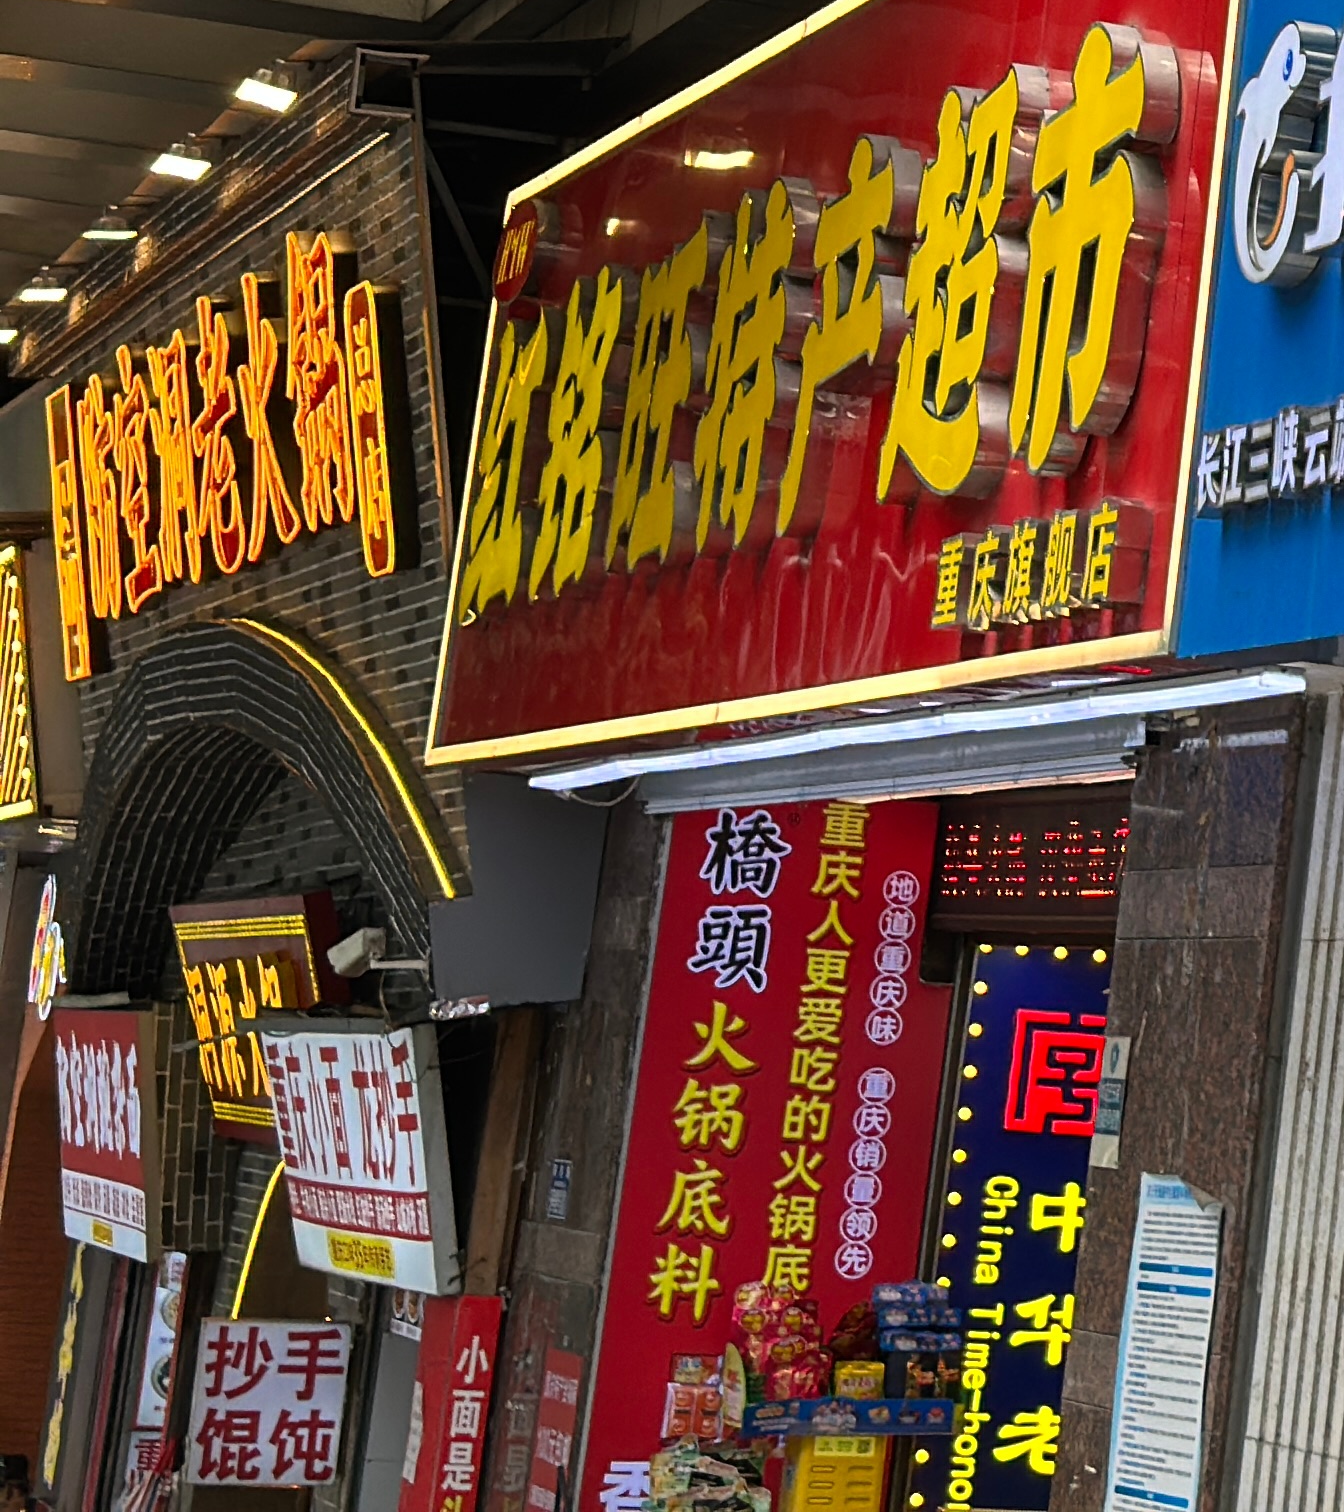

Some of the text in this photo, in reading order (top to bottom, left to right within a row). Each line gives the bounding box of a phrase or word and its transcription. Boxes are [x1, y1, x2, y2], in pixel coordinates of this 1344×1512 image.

[458, 21, 1145, 624] 红铭旺特产超市
[1197, 408, 1299, 512] 长江三峡
[931, 502, 1120, 631] 重庆旗舰店
[264, 1040, 353, 1181] 重庆小面
[647, 807, 793, 1324] 橋頭 火锅底料
[761, 800, 871, 1291] 重庆人更爱吃的火锅底
[836, 873, 917, 1277] 地道重庆味 重庆销量领先
[972, 1174, 1021, 1286] China
[204, 1324, 346, 1400] 抄手
[992, 1181, 1087, 1476] 中华老
[195, 1407, 334, 1483] 馄饨
